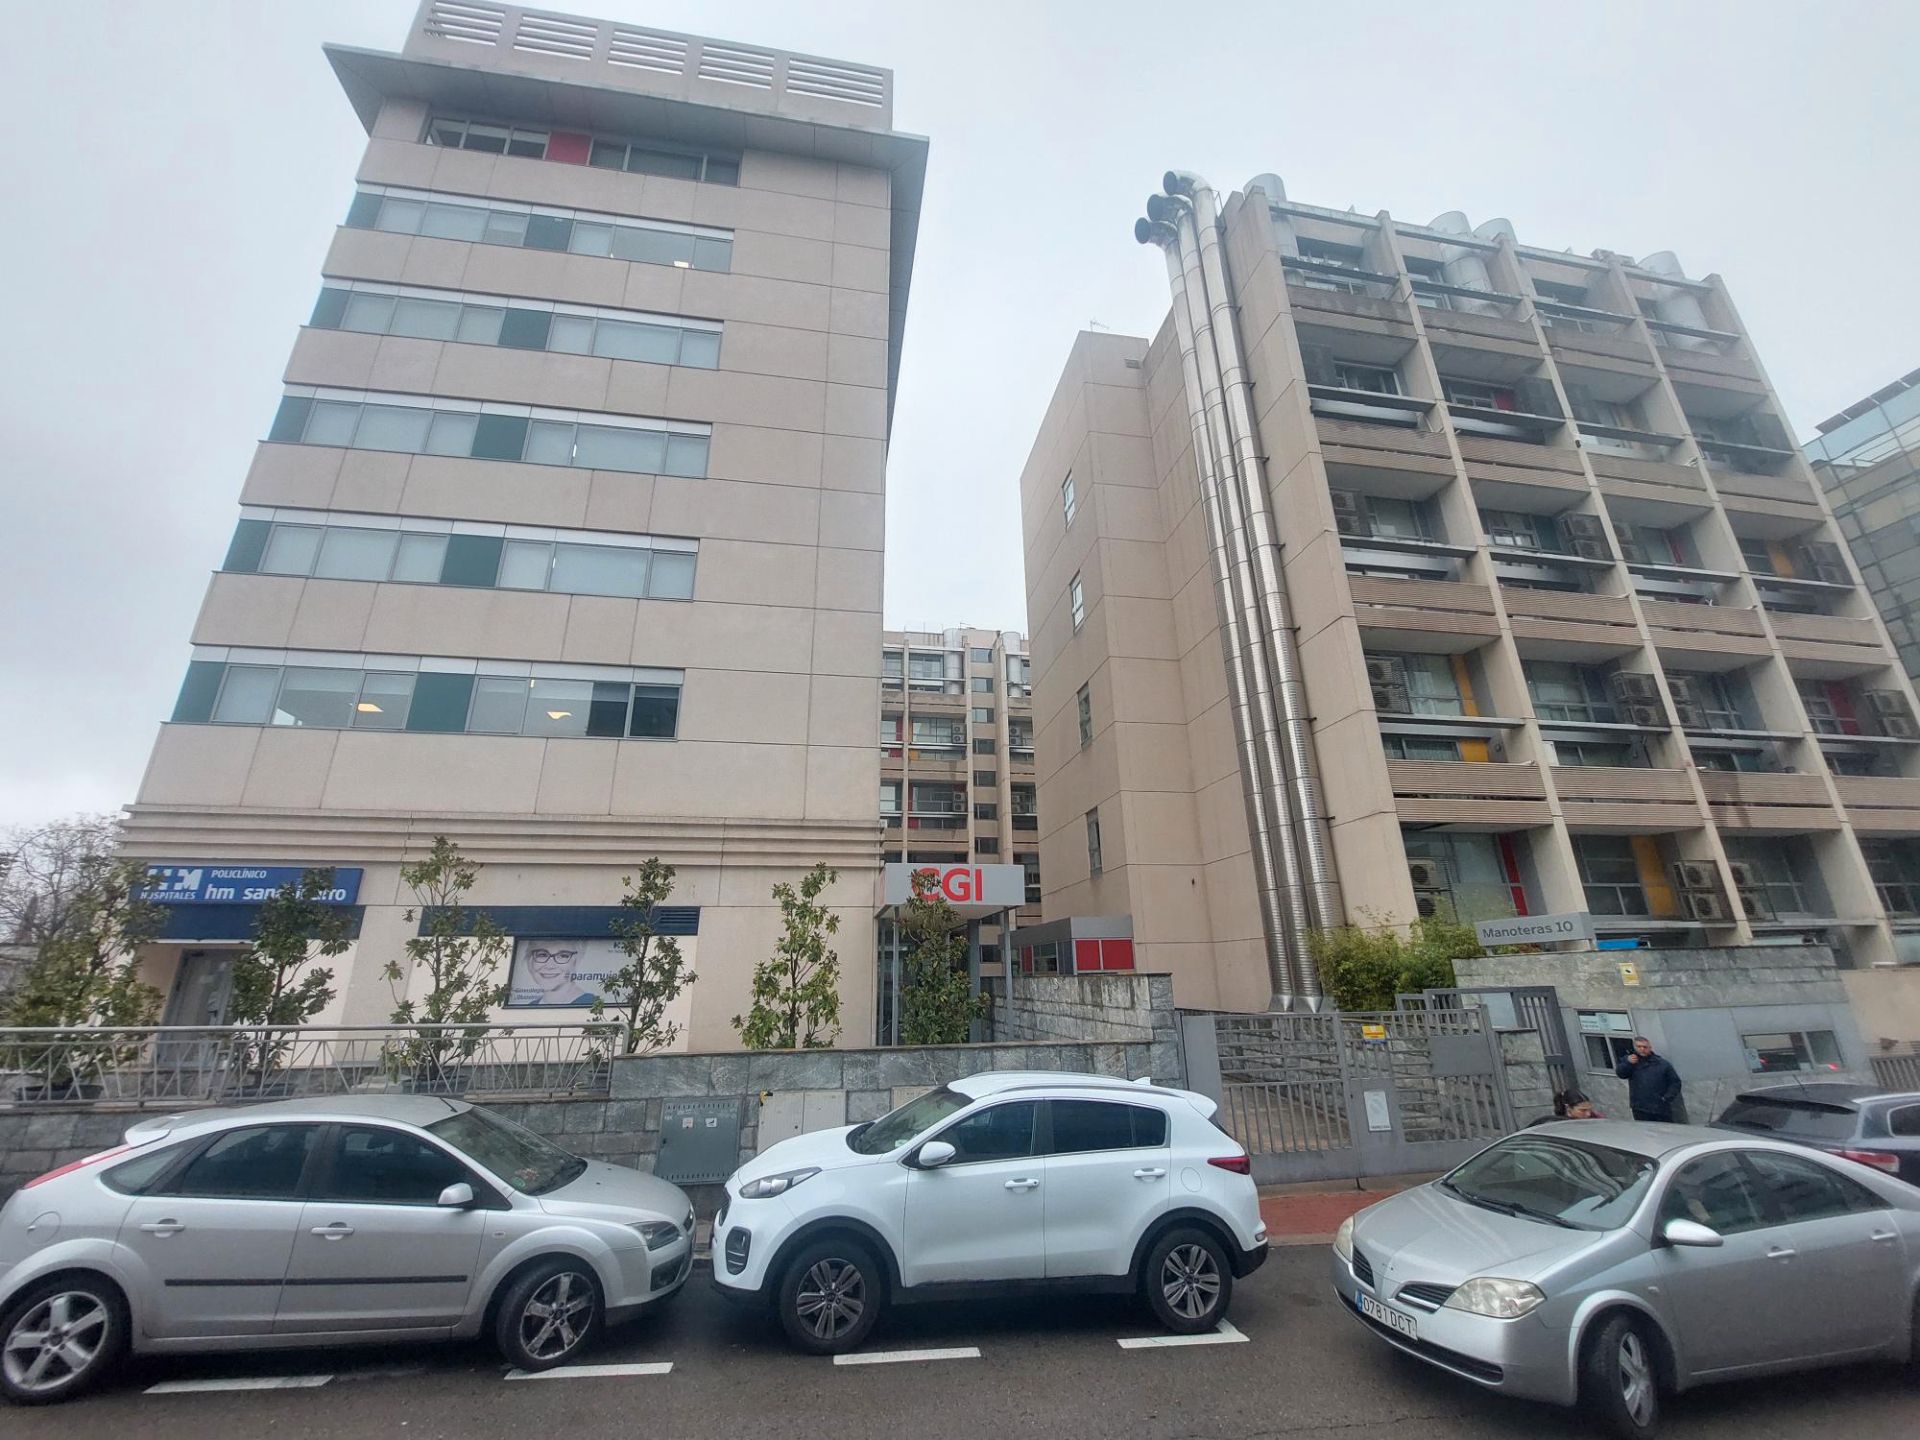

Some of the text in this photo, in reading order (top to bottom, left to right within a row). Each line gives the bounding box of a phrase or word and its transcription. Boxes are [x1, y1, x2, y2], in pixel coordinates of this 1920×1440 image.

[211, 868, 267, 879] POLICLÍNICO
[204, 884, 235, 900] hm
[911, 866, 983, 902] CGI
[1482, 920, 1574, 939] Manoteras 10
[1363, 1297, 1412, 1335] 0781 DCT
